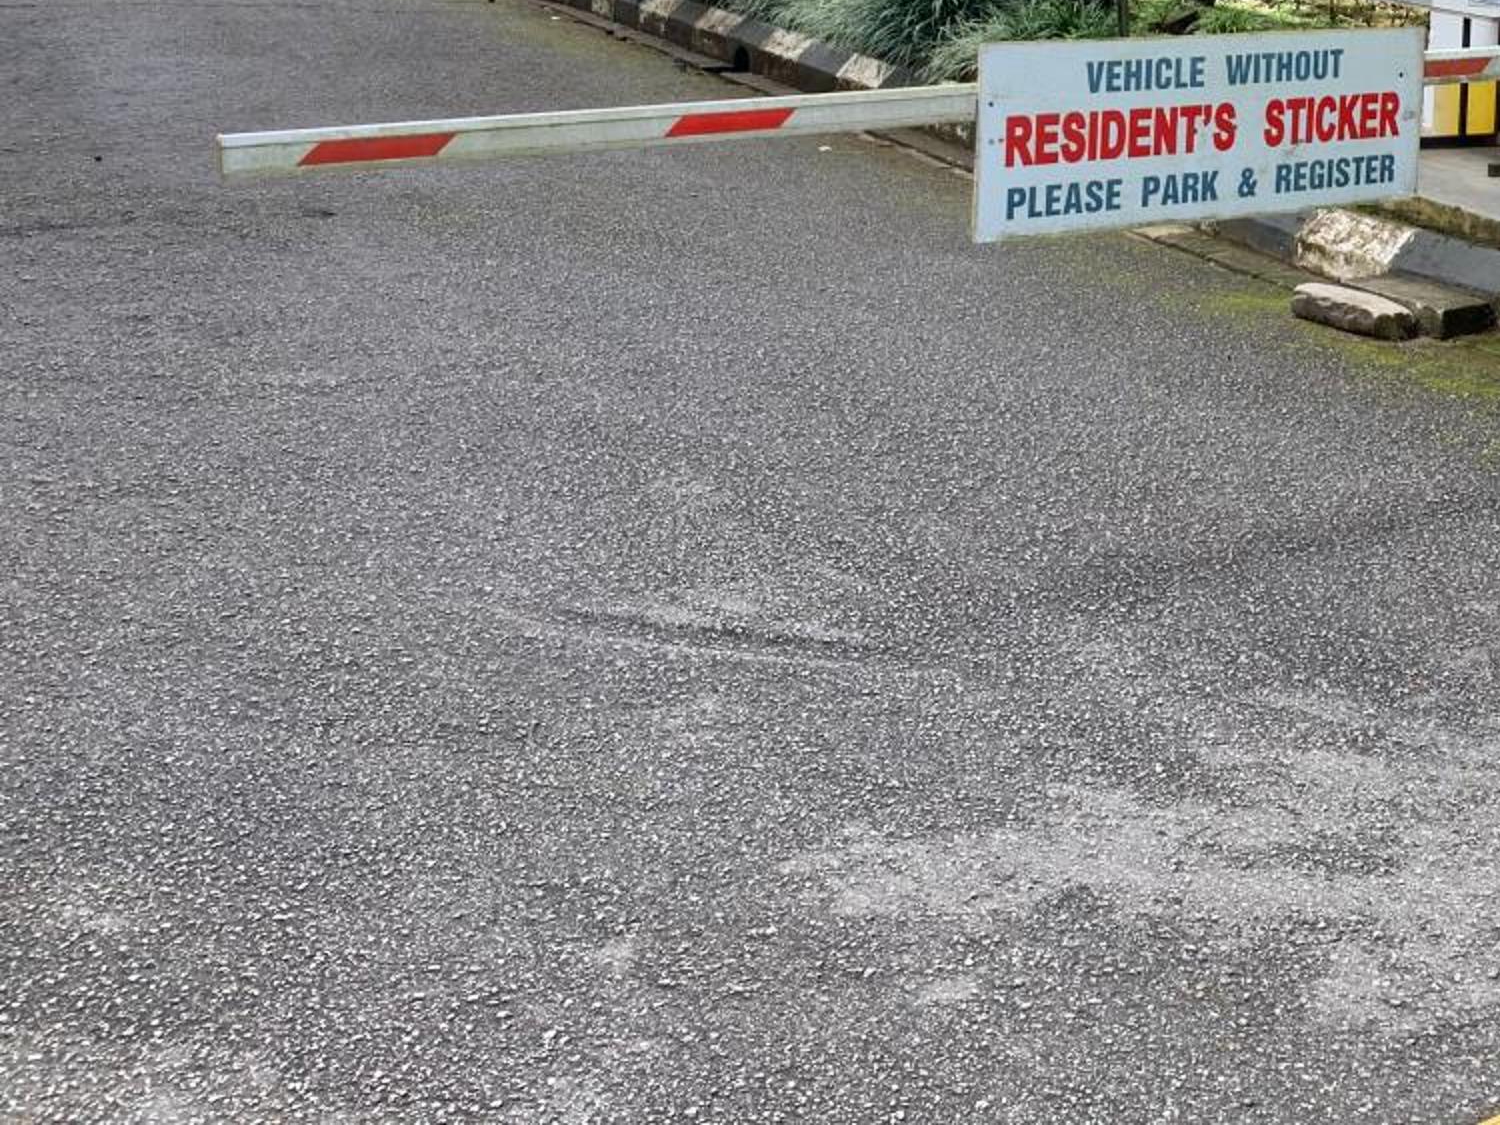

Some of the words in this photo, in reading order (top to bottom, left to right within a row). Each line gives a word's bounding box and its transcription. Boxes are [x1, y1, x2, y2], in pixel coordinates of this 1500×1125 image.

[1086, 56, 1206, 94] VEHICLE
[1225, 48, 1344, 86] WITHOUT
[1004, 102, 1237, 168] RESIDENT'S
[1263, 91, 1400, 148] STICKER
[1006, 178, 1122, 220] PLEASE
[1141, 170, 1219, 207] PARK
[1237, 167, 1258, 198] &
[1275, 154, 1396, 194] REGISTER
